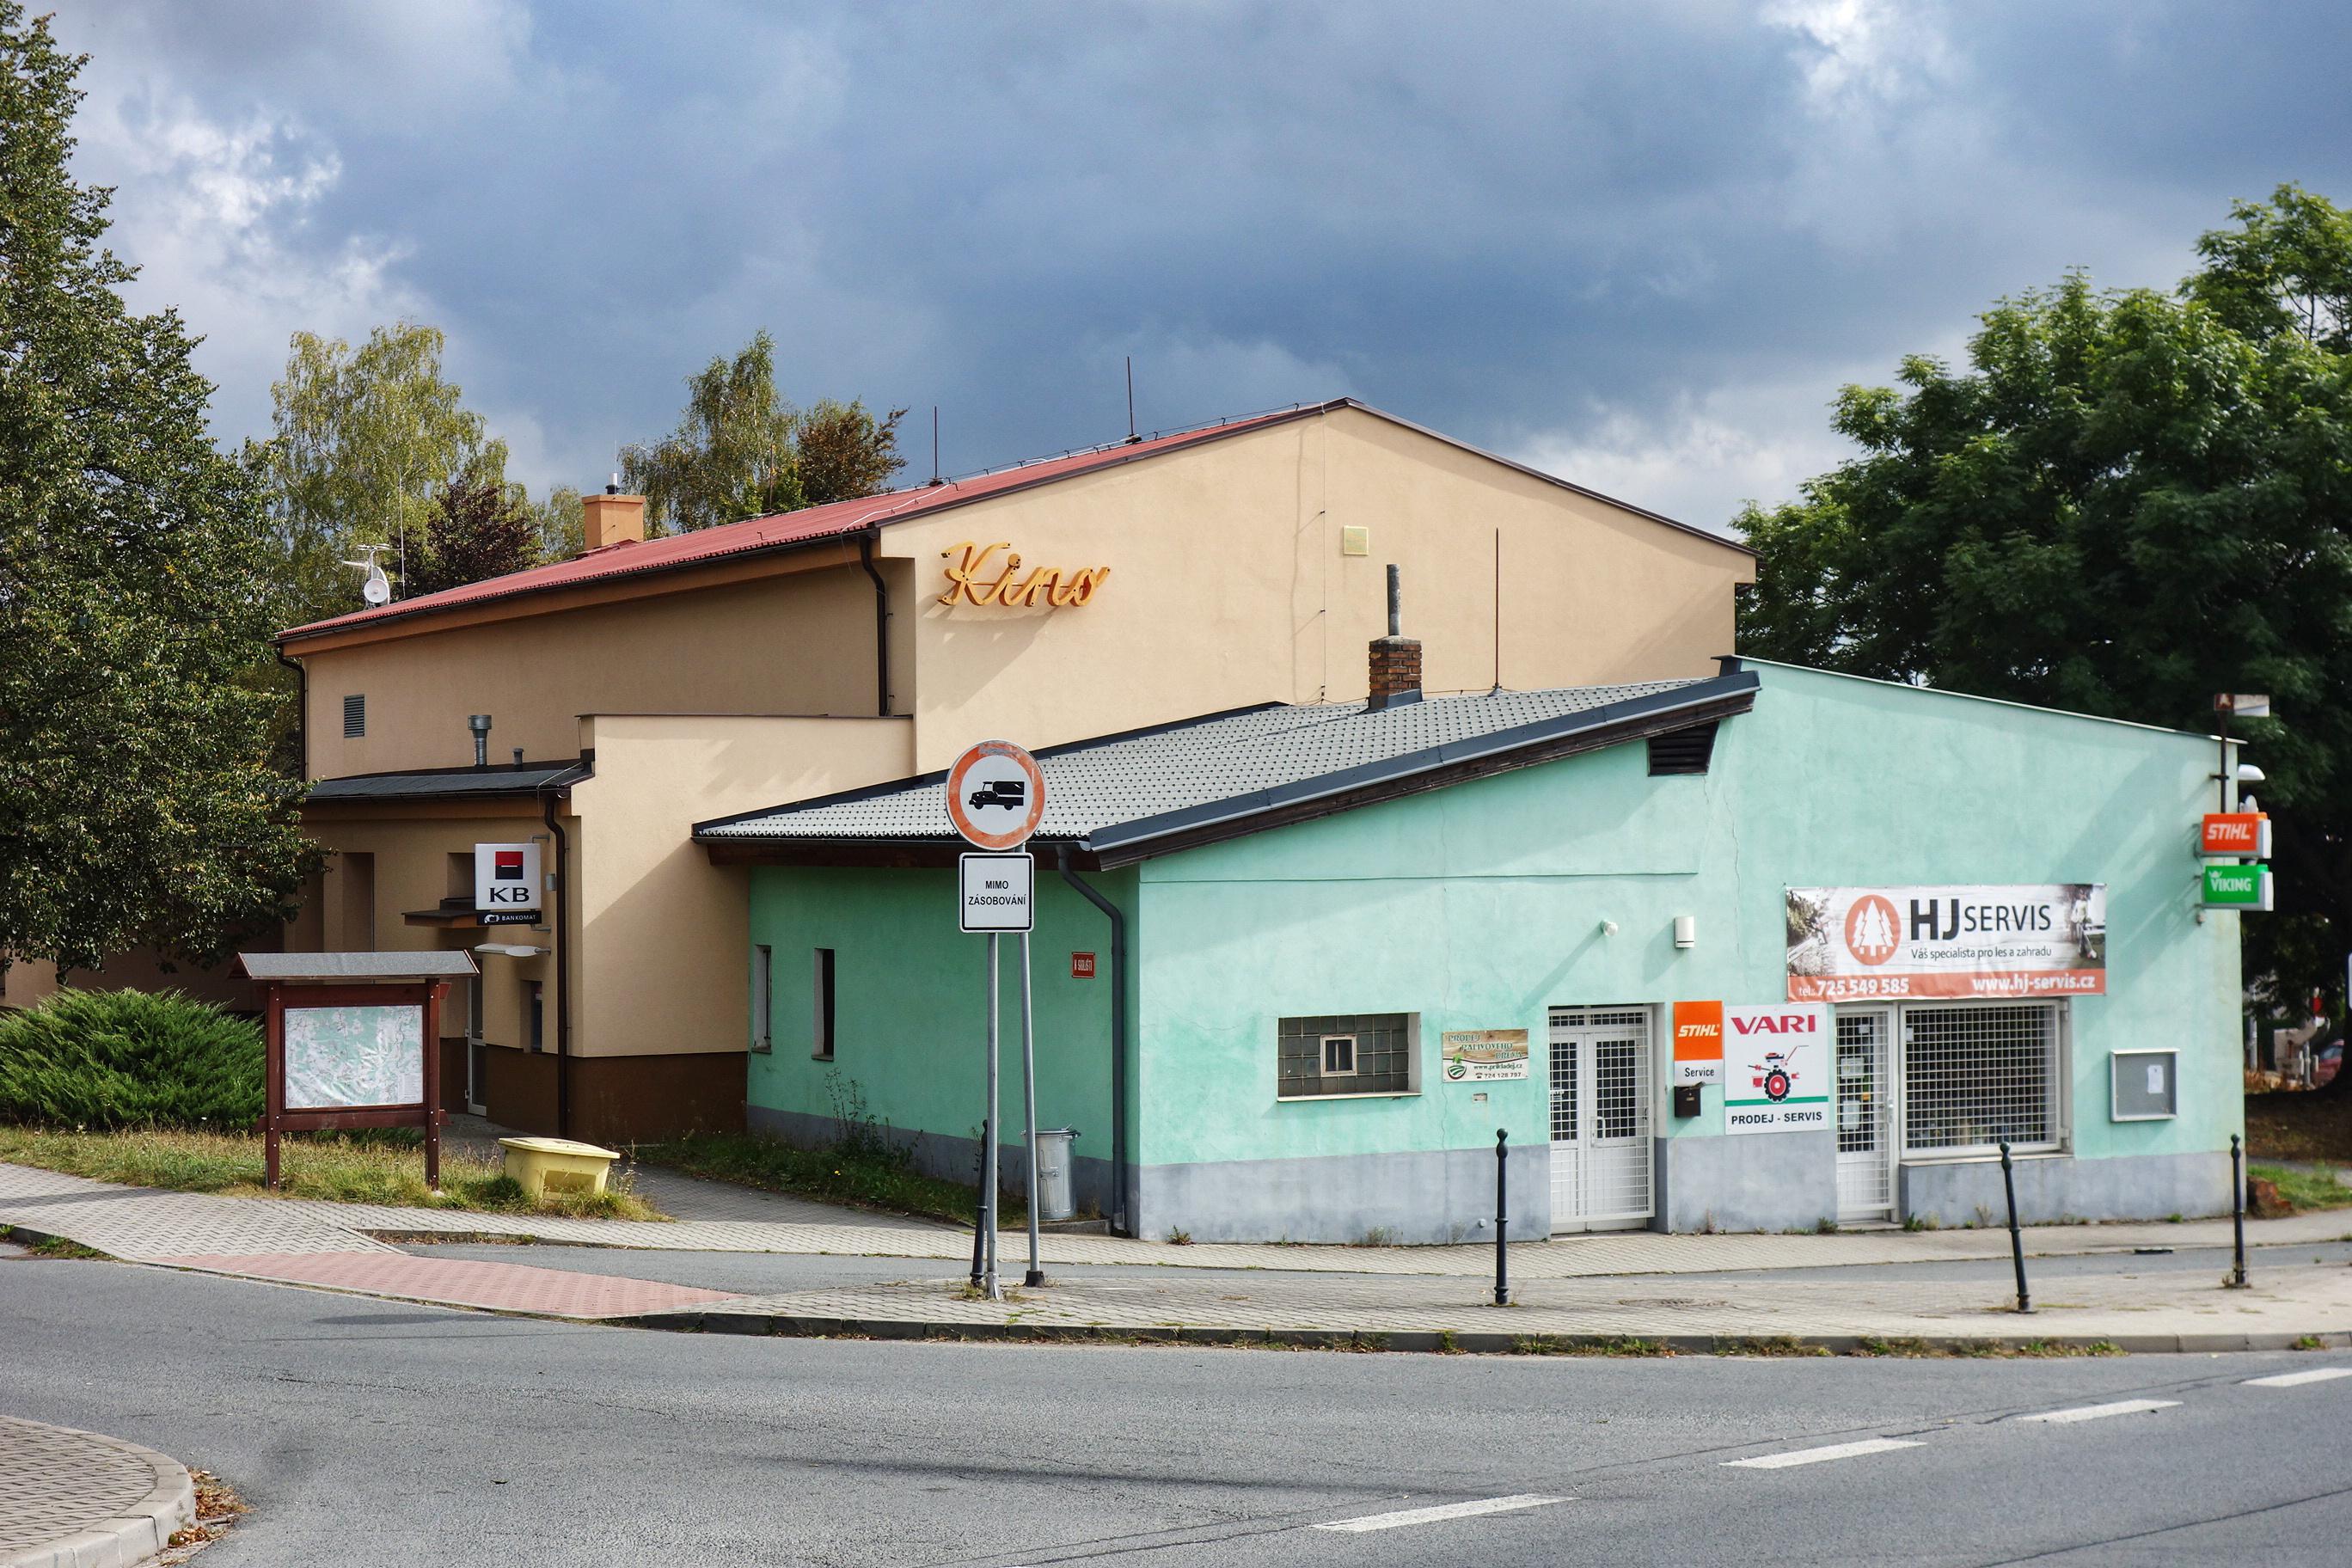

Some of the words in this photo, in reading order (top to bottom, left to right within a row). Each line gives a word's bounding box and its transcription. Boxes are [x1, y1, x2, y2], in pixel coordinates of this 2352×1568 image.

[937, 540, 1111, 607] Kino
[2207, 823, 2251, 841] STIHL
[985, 880, 1009, 890] MIMO
[2210, 878, 2252, 892] VIKING
[489, 887, 530, 903] KB
[968, 893, 1027, 906] ZÁSOBOVÁNÍ
[1910, 898, 1960, 941] HJ
[1964, 904, 2052, 933] SERVIS
[1911, 947, 1928, 959] Váš
[1930, 946, 1975, 961] specialista
[1978, 949, 1993, 961] pro
[1995, 946, 2007, 957] les
[2017, 946, 2052, 957] zahradu
[1816, 978, 1847, 996] 725
[1849, 977, 1878, 995] 549
[1881, 977, 1909, 994] 585
[1973, 973, 2095, 994] www.hj-servis.cz
[1678, 1024, 1719, 1038] STIHL
[1730, 1014, 1816, 1035] VARI
[1448, 1034, 1480, 1043] PRODEJ
[1685, 1067, 1715, 1078] Service
[1731, 1115, 1774, 1125] PRODEJ
[1784, 1112, 1823, 1123] SERVIS
